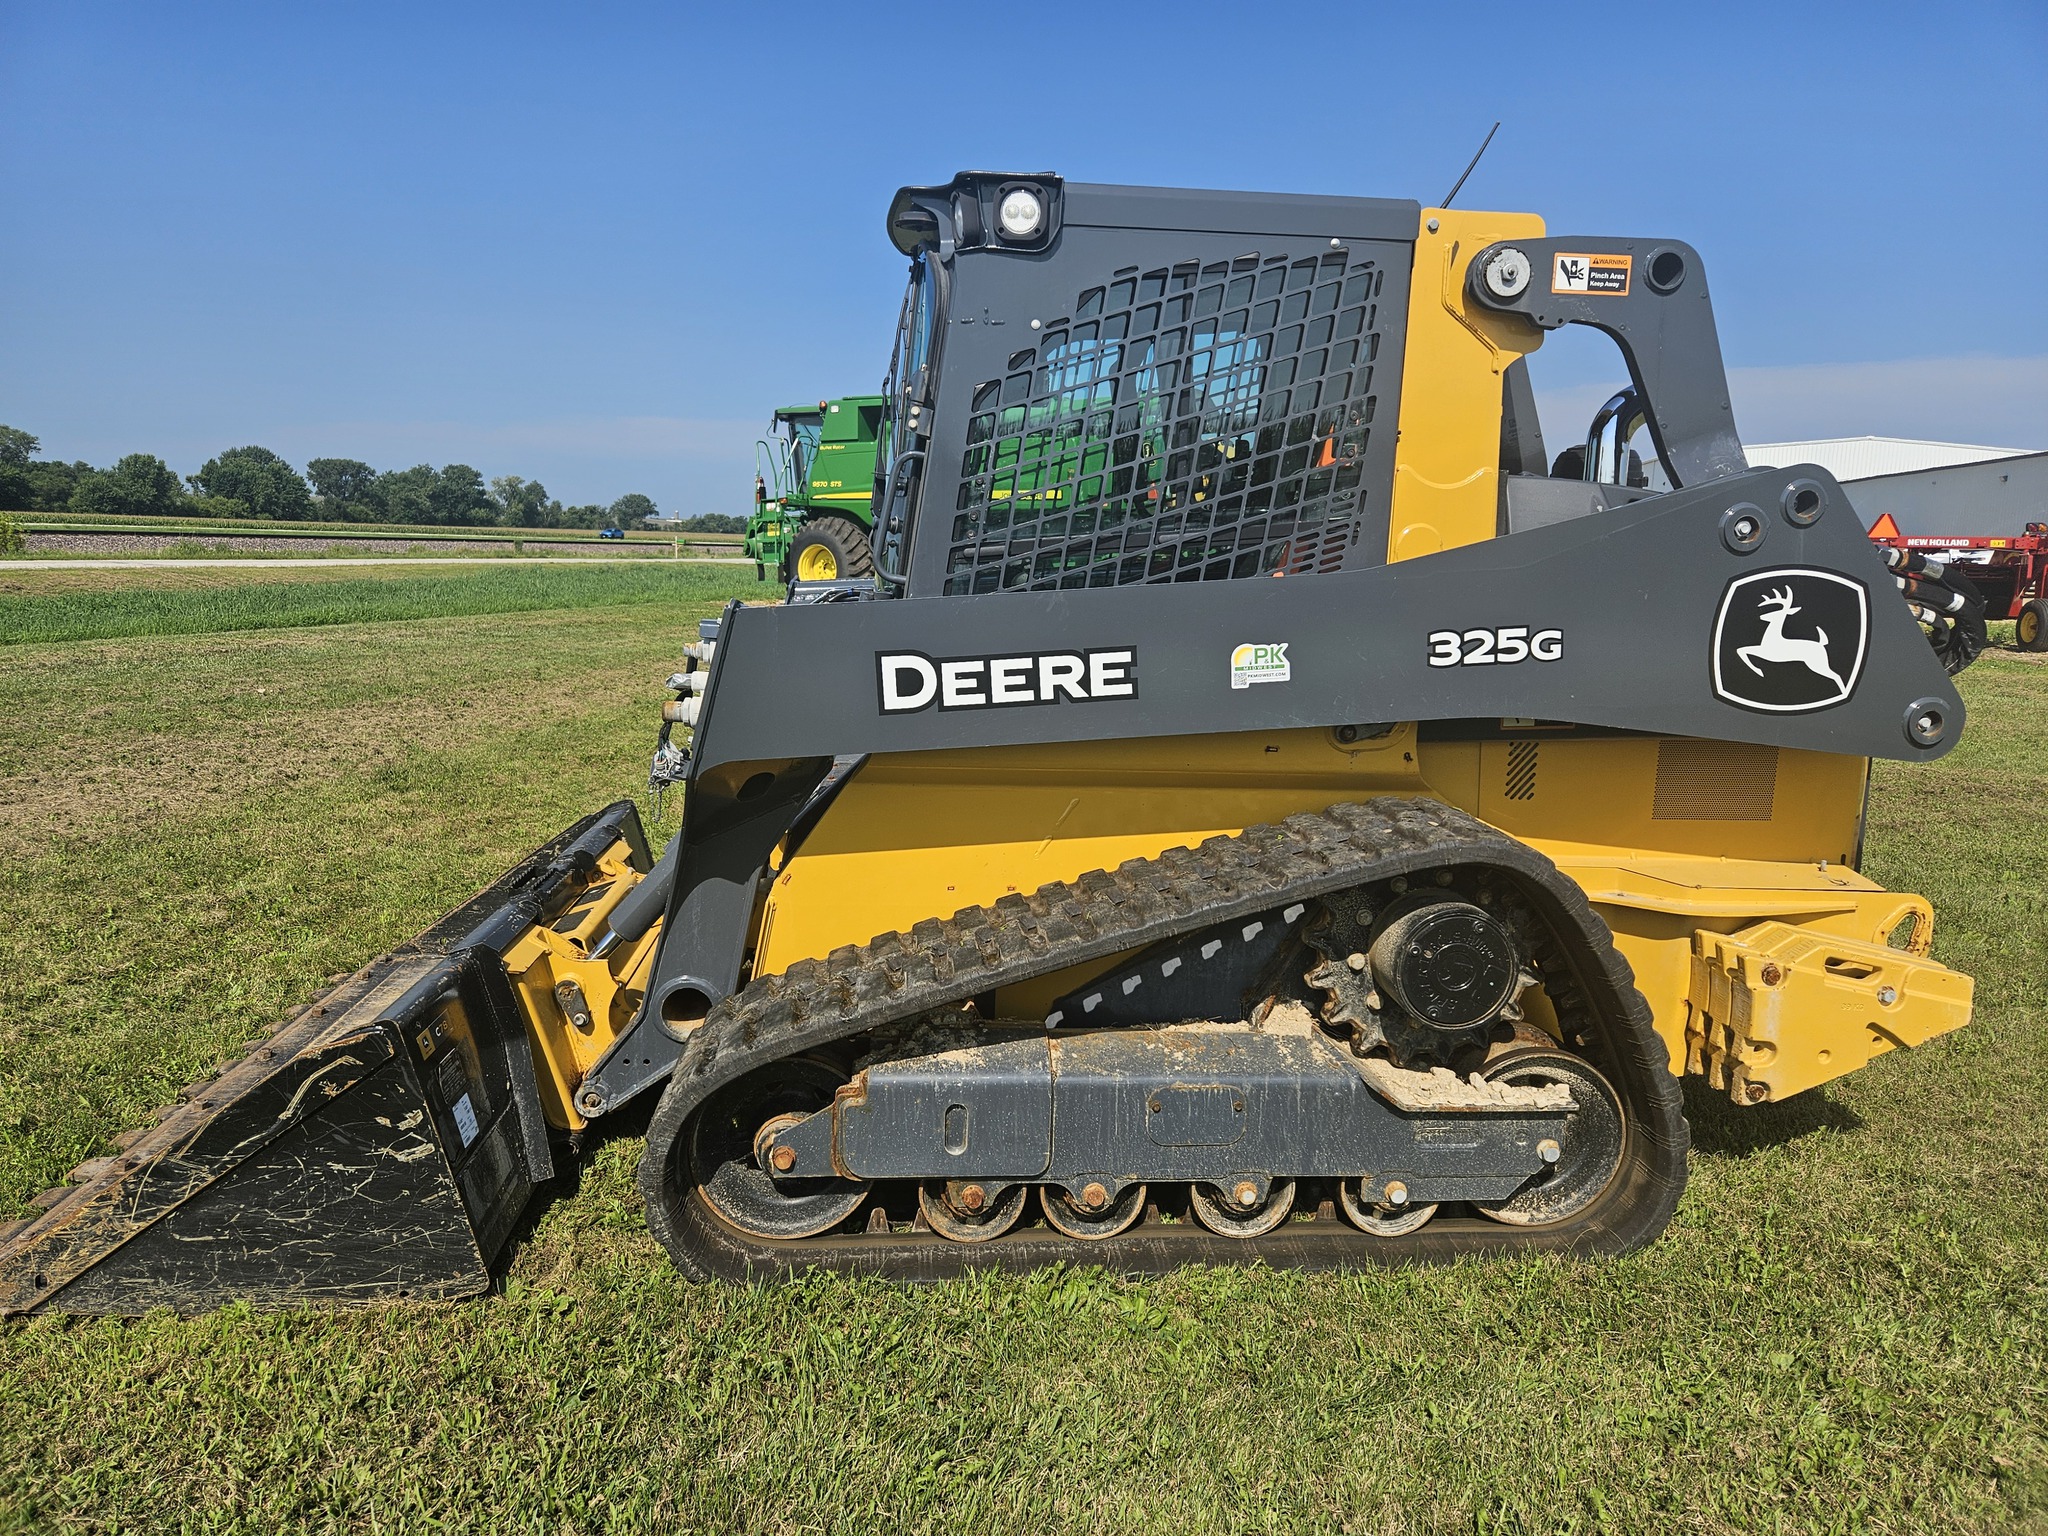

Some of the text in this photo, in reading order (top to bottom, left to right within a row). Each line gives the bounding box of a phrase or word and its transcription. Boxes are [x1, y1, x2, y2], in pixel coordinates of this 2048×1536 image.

[1907, 538, 1970, 547] NEW HOLLAND
[1429, 627, 1562, 667] 325G
[880, 651, 1133, 710] DEERE
